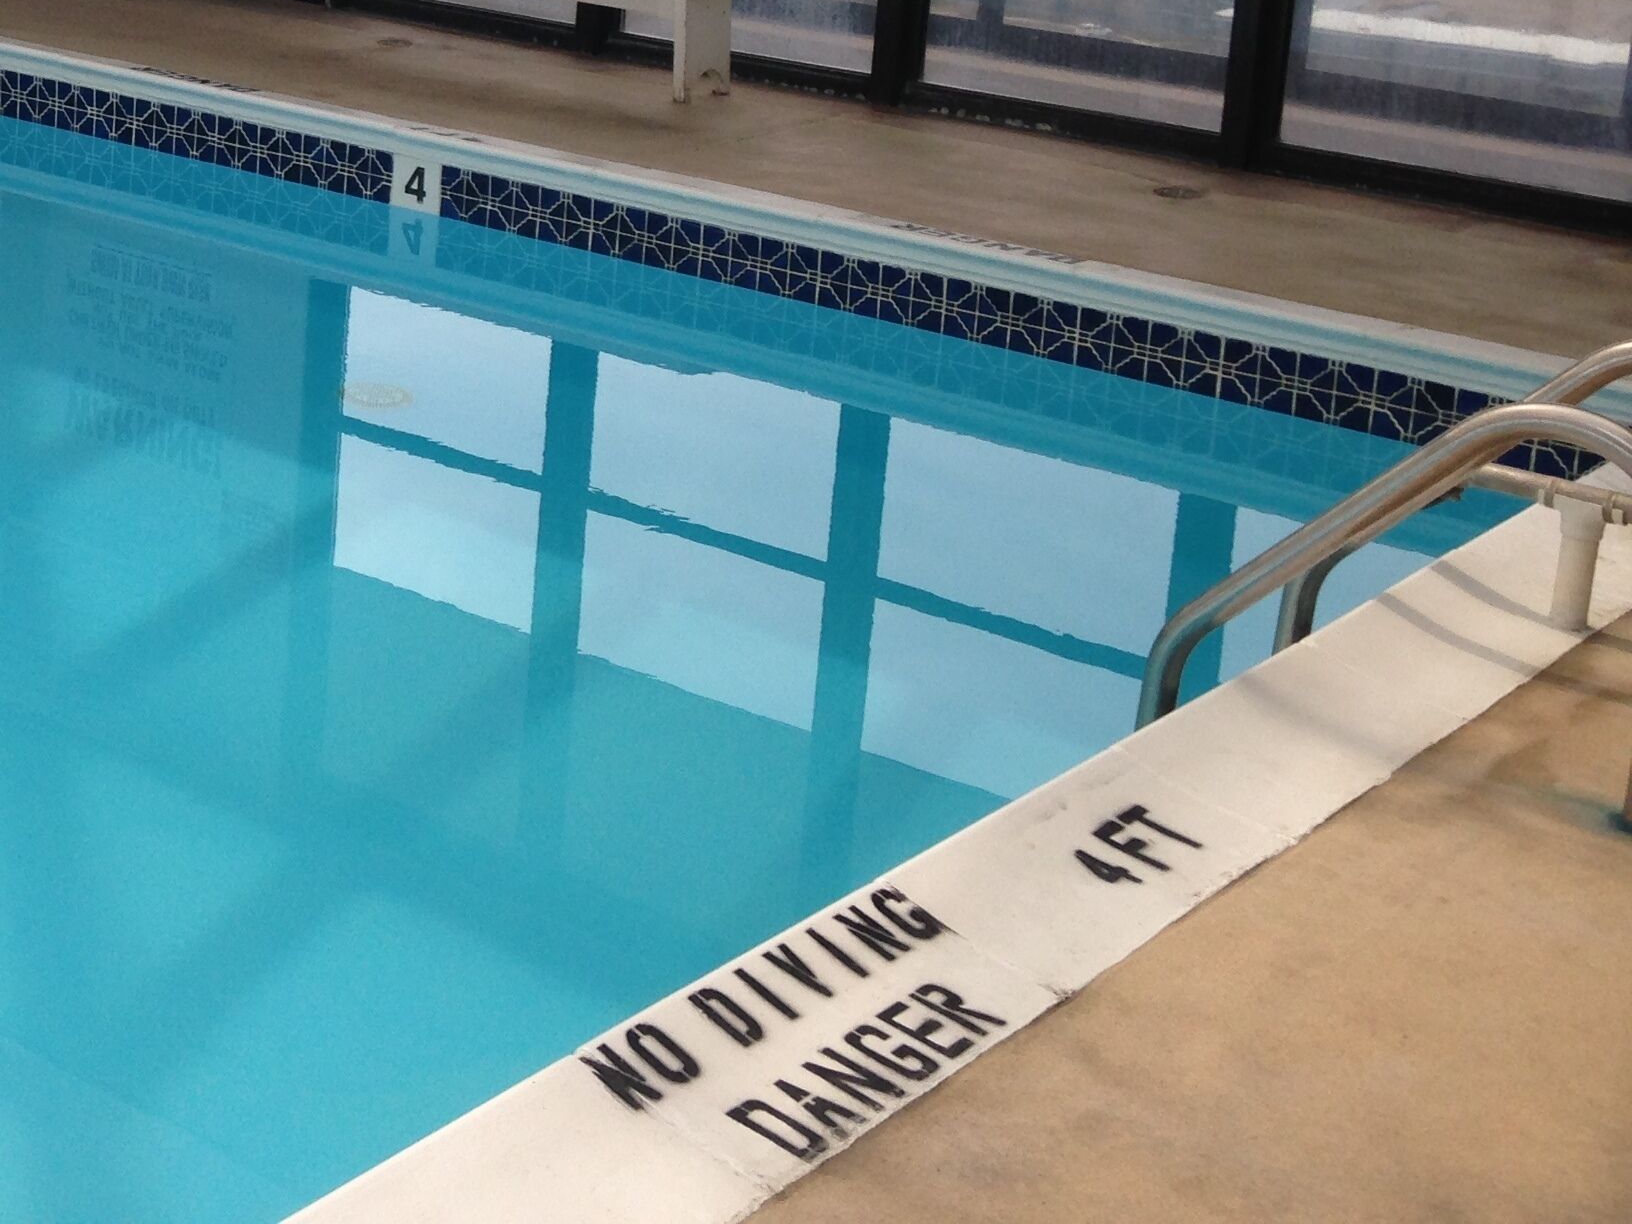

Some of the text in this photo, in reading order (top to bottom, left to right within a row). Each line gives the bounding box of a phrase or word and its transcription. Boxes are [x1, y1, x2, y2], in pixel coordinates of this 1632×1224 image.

[405, 167, 426, 203] 4
[578, 886, 945, 1111] NO DIVING
[726, 981, 1006, 1162] DANGER
